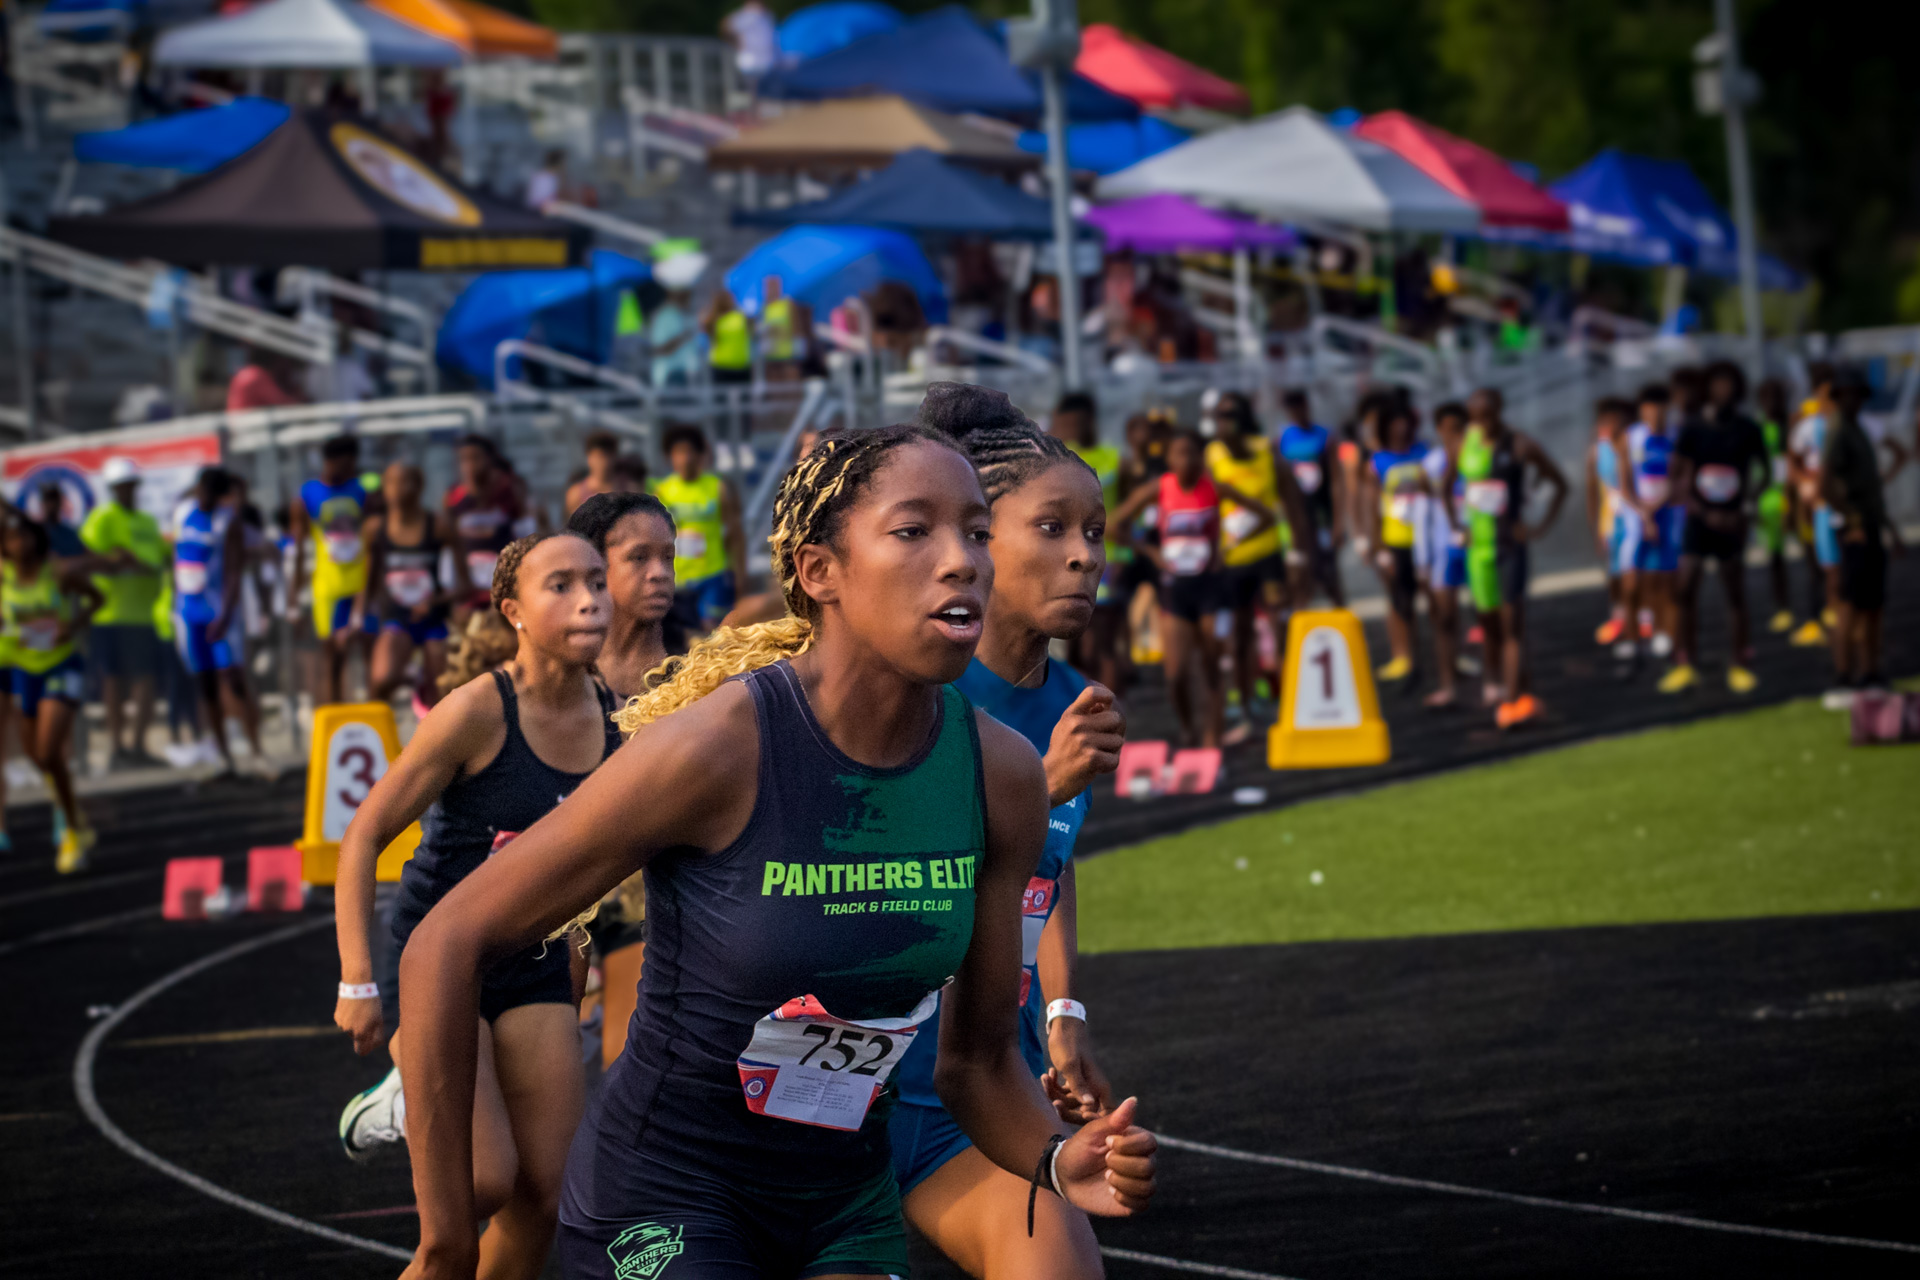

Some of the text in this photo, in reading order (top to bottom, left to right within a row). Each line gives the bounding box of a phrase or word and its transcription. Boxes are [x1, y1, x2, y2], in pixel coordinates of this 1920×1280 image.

[1311, 647, 1333, 700] 1
[338, 747, 376, 809] 3
[761, 855, 975, 896] PANTHERS ELIT
[823, 899, 952, 915] TRACK & FIELD CLUB
[799, 1024, 893, 1076] 752
[620, 1245, 678, 1275] PANTHERS
[637, 1257, 658, 1270] ELITE
